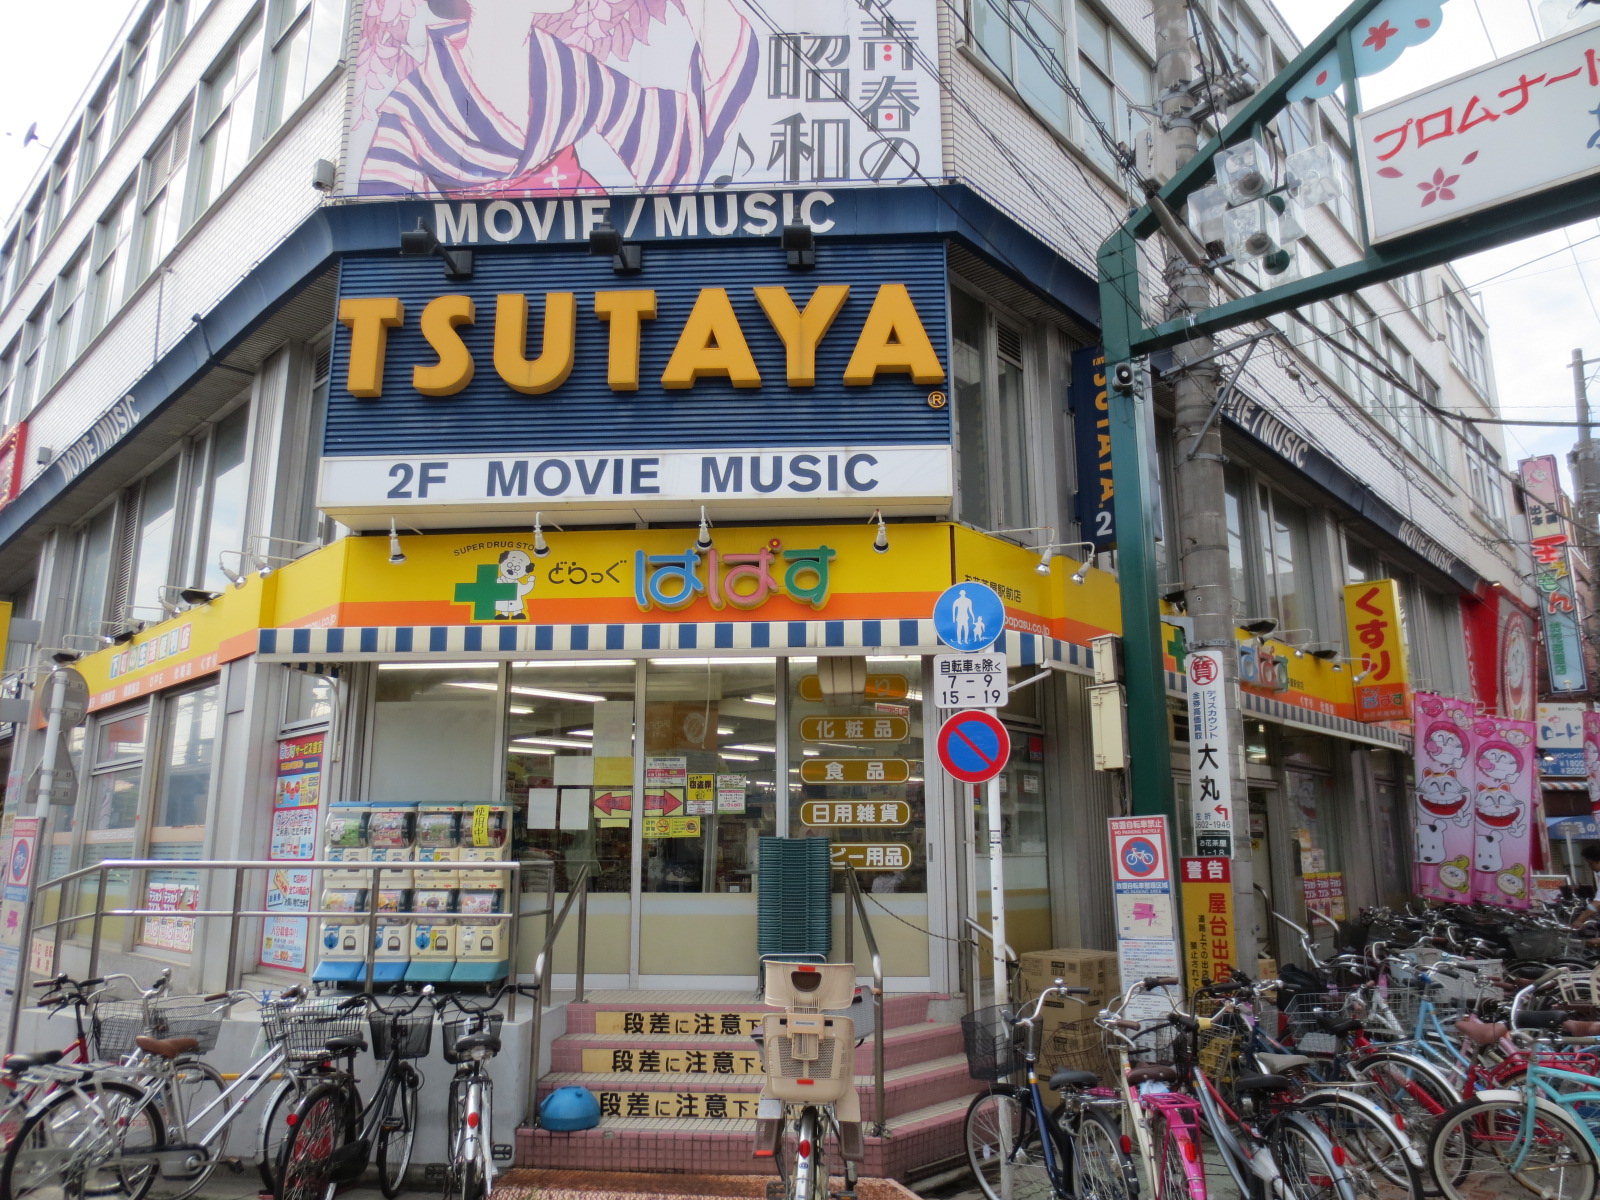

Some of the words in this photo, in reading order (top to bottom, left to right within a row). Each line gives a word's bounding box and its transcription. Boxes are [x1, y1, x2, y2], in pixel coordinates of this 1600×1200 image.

[767, 32, 851, 186] 昭和
[338, 282, 945, 397] TSUTAYA
[57, 394, 141, 484] MOVIE/MUSIC
[1226, 386, 1310, 468] VIE/MUSIC
[387, 461, 448, 499] 2F
[486, 456, 661, 498] MOVIE
[700, 452, 879, 494] MUSIC
[453, 542, 486, 557] SUPER
[486, 540, 514, 550] DRUG
[548, 559, 628, 585] どらっぐ
[634, 537, 837, 611] ぱぱす
[1355, 586, 1391, 681] くすり
[940, 659, 1001, 674] 自転車を除く
[1192, 659, 1217, 683] 質
[1206, 690, 1218, 739] ディスカウント
[815, 720, 893, 739] 化粧品
[824, 762, 885, 780] 食品
[1197, 743, 1220, 802] 大丸
[812, 803, 899, 823] 日用雑貨
[1111, 819, 1163, 830] 放置自転車禁止
[1194, 820, 1231, 829] 3602-1946
[1196, 812, 1212, 821] 左折
[474, 806, 487, 845] 使用中止
[1199, 839, 1227, 848] お花茶屋
[829, 847, 903, 867] ビー用品
[1186, 860, 1224, 880] 警告
